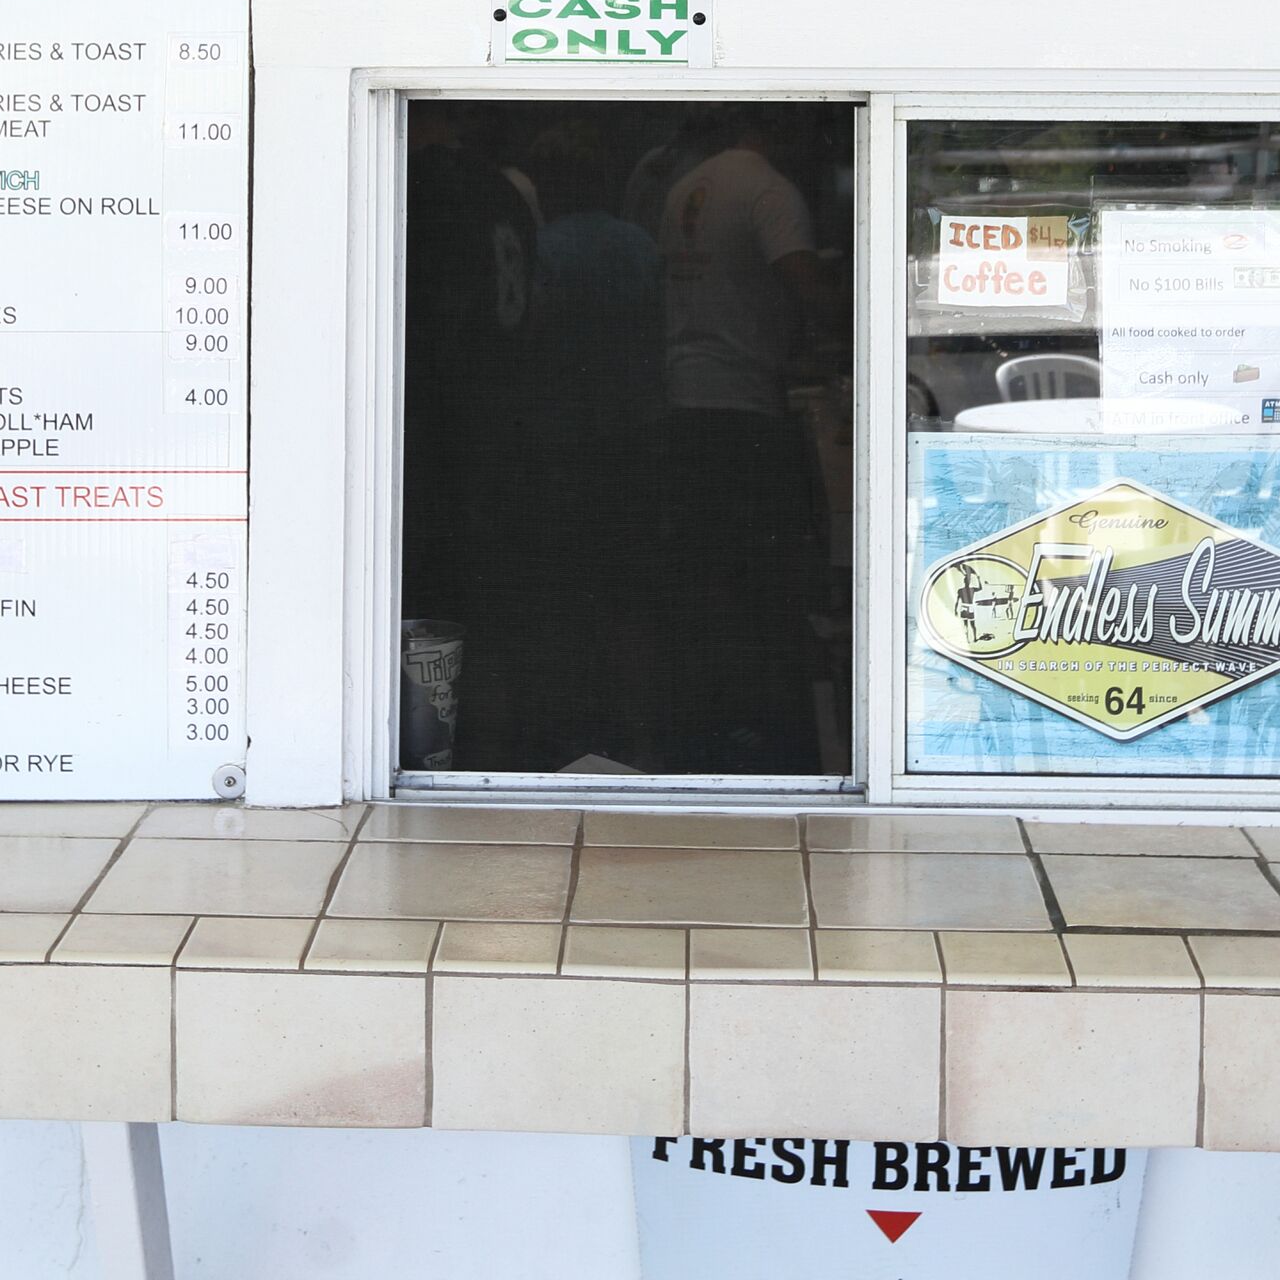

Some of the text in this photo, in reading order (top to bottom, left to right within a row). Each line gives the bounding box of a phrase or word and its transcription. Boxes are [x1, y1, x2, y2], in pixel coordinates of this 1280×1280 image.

[49, 42, 64, 61] &
[71, 42, 147, 61] TOAST
[178, 42, 221, 61] 8.50
[512, 29, 688, 55] ONLY
[949, 222, 1023, 250] ICED
[1125, 239, 1211, 254] No Smoking
[944, 261, 1047, 295] Coffee
[1129, 278, 1223, 293] No $100 Bills
[175, 307, 229, 326] 10.00
[1112, 328, 1246, 337] All food cooked to order
[1139, 371, 1208, 387] Cash only
[54, 485, 164, 508] TREATS
[1069, 510, 1169, 534] Genuine
[1014, 542, 1159, 644] Endless
[185, 598, 230, 616] 4.50
[185, 647, 229, 665] 4.00
[998, 660, 1257, 673] IN SEARCH OF THE PERFECT WAVE
[1067, 686, 1177, 715] seeking 64 since
[186, 723, 229, 741] 3.00
[872, 1141, 1126, 1192] BREWED
